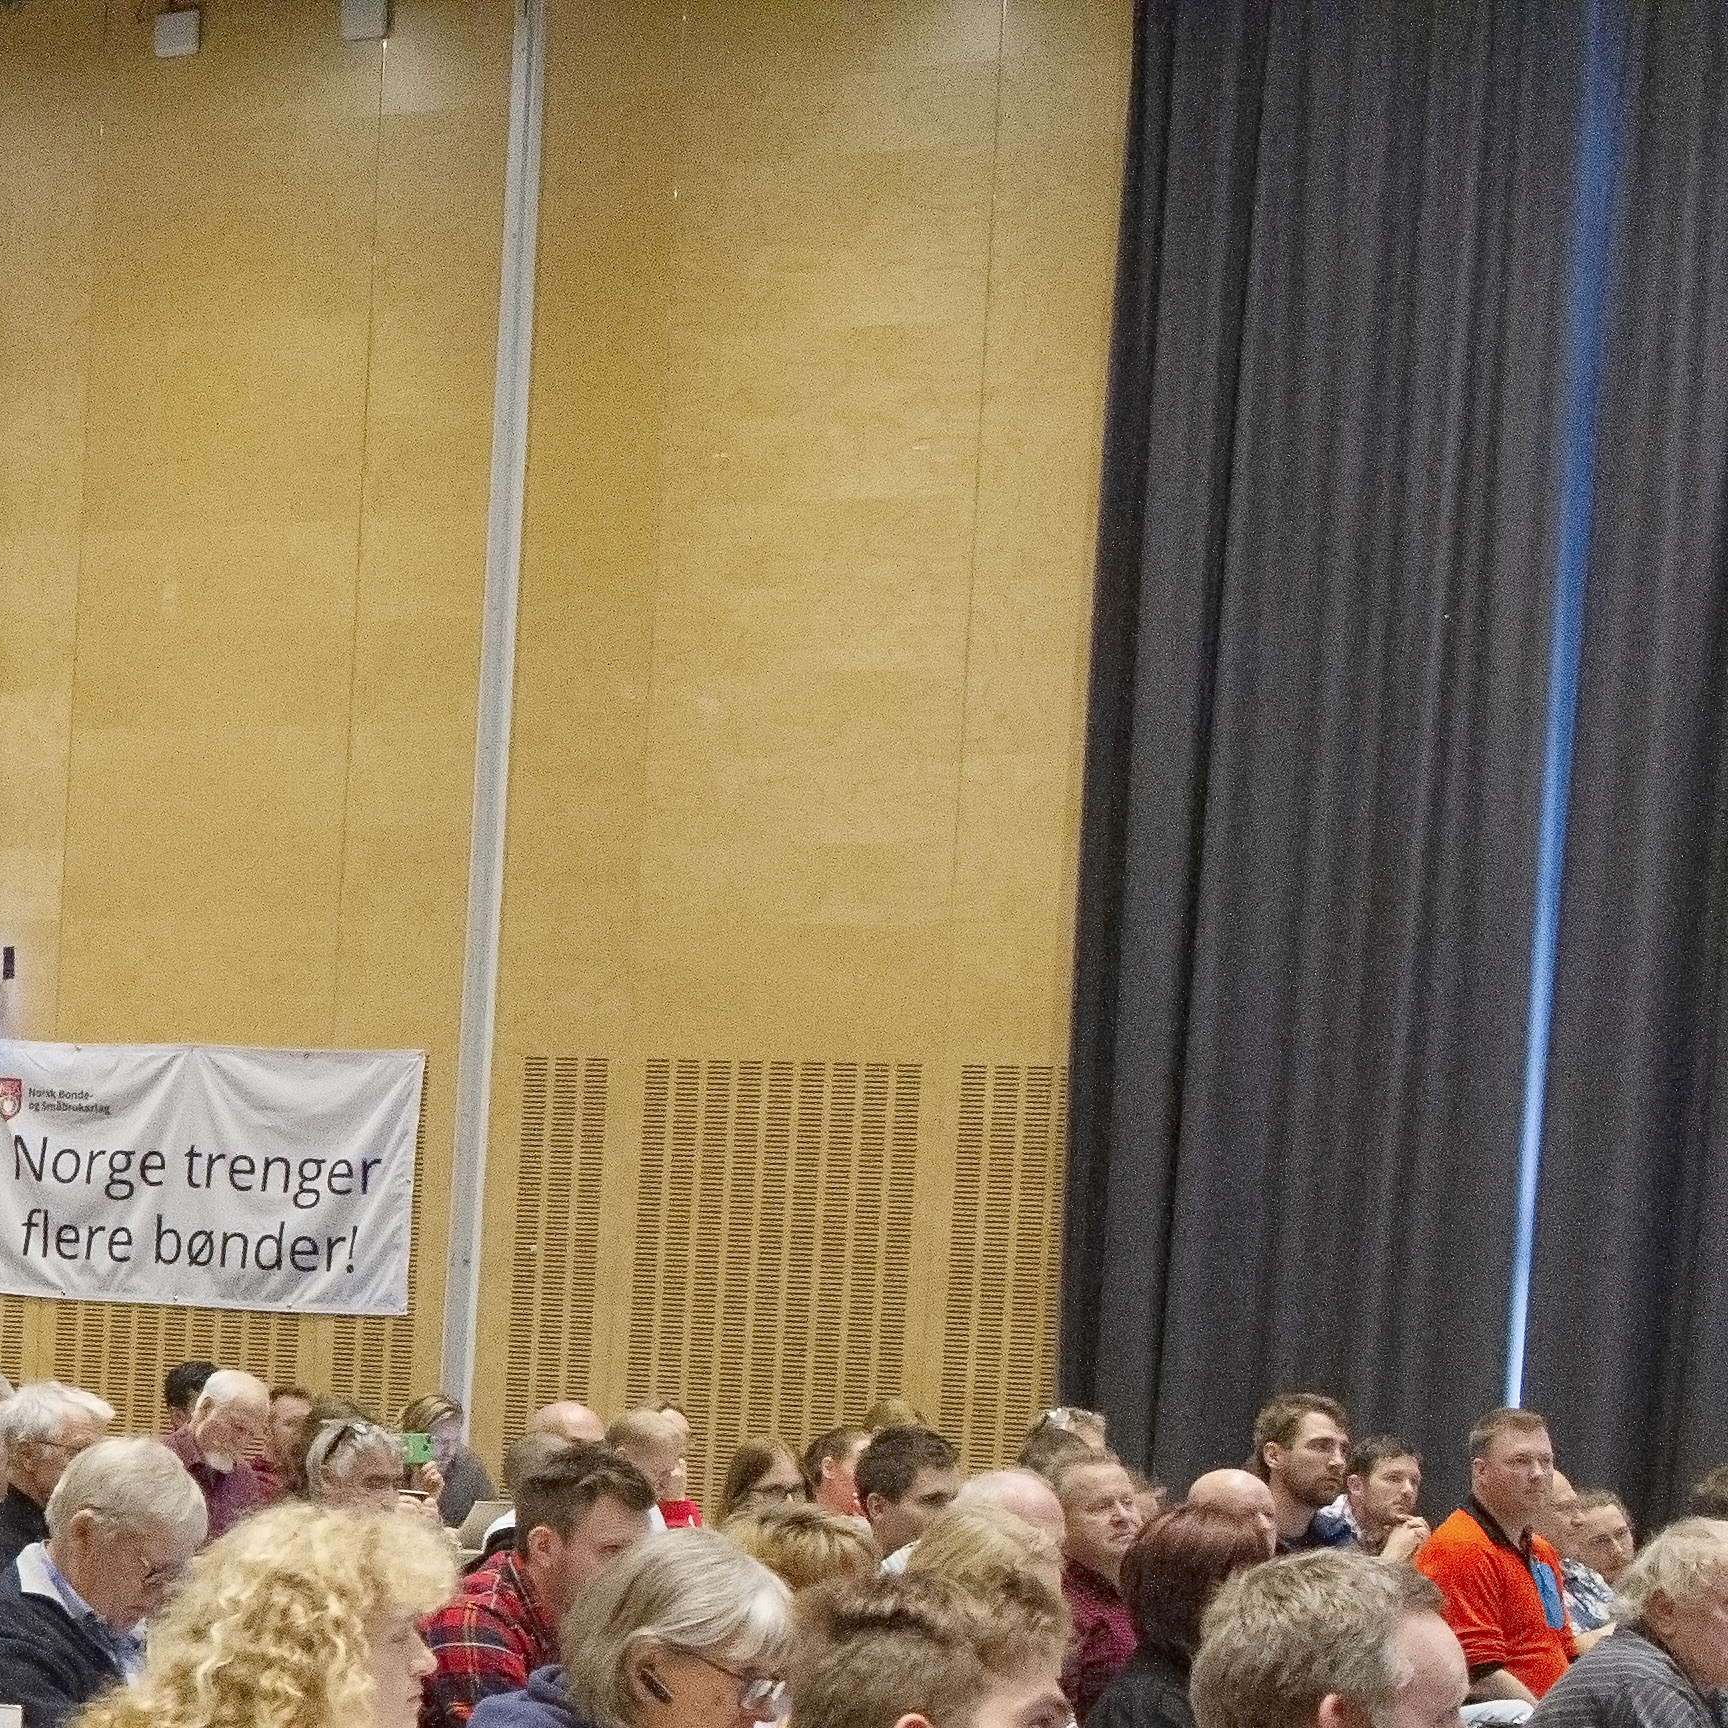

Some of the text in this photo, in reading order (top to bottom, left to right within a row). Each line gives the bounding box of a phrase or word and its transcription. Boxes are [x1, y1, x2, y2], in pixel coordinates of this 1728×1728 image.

[28, 1087, 93, 1100] Norsk Bonde-
[28, 1102, 39, 1112] og
[13, 1134, 383, 1209] Norge trenger
[21, 1208, 358, 1275] flere bønder!
